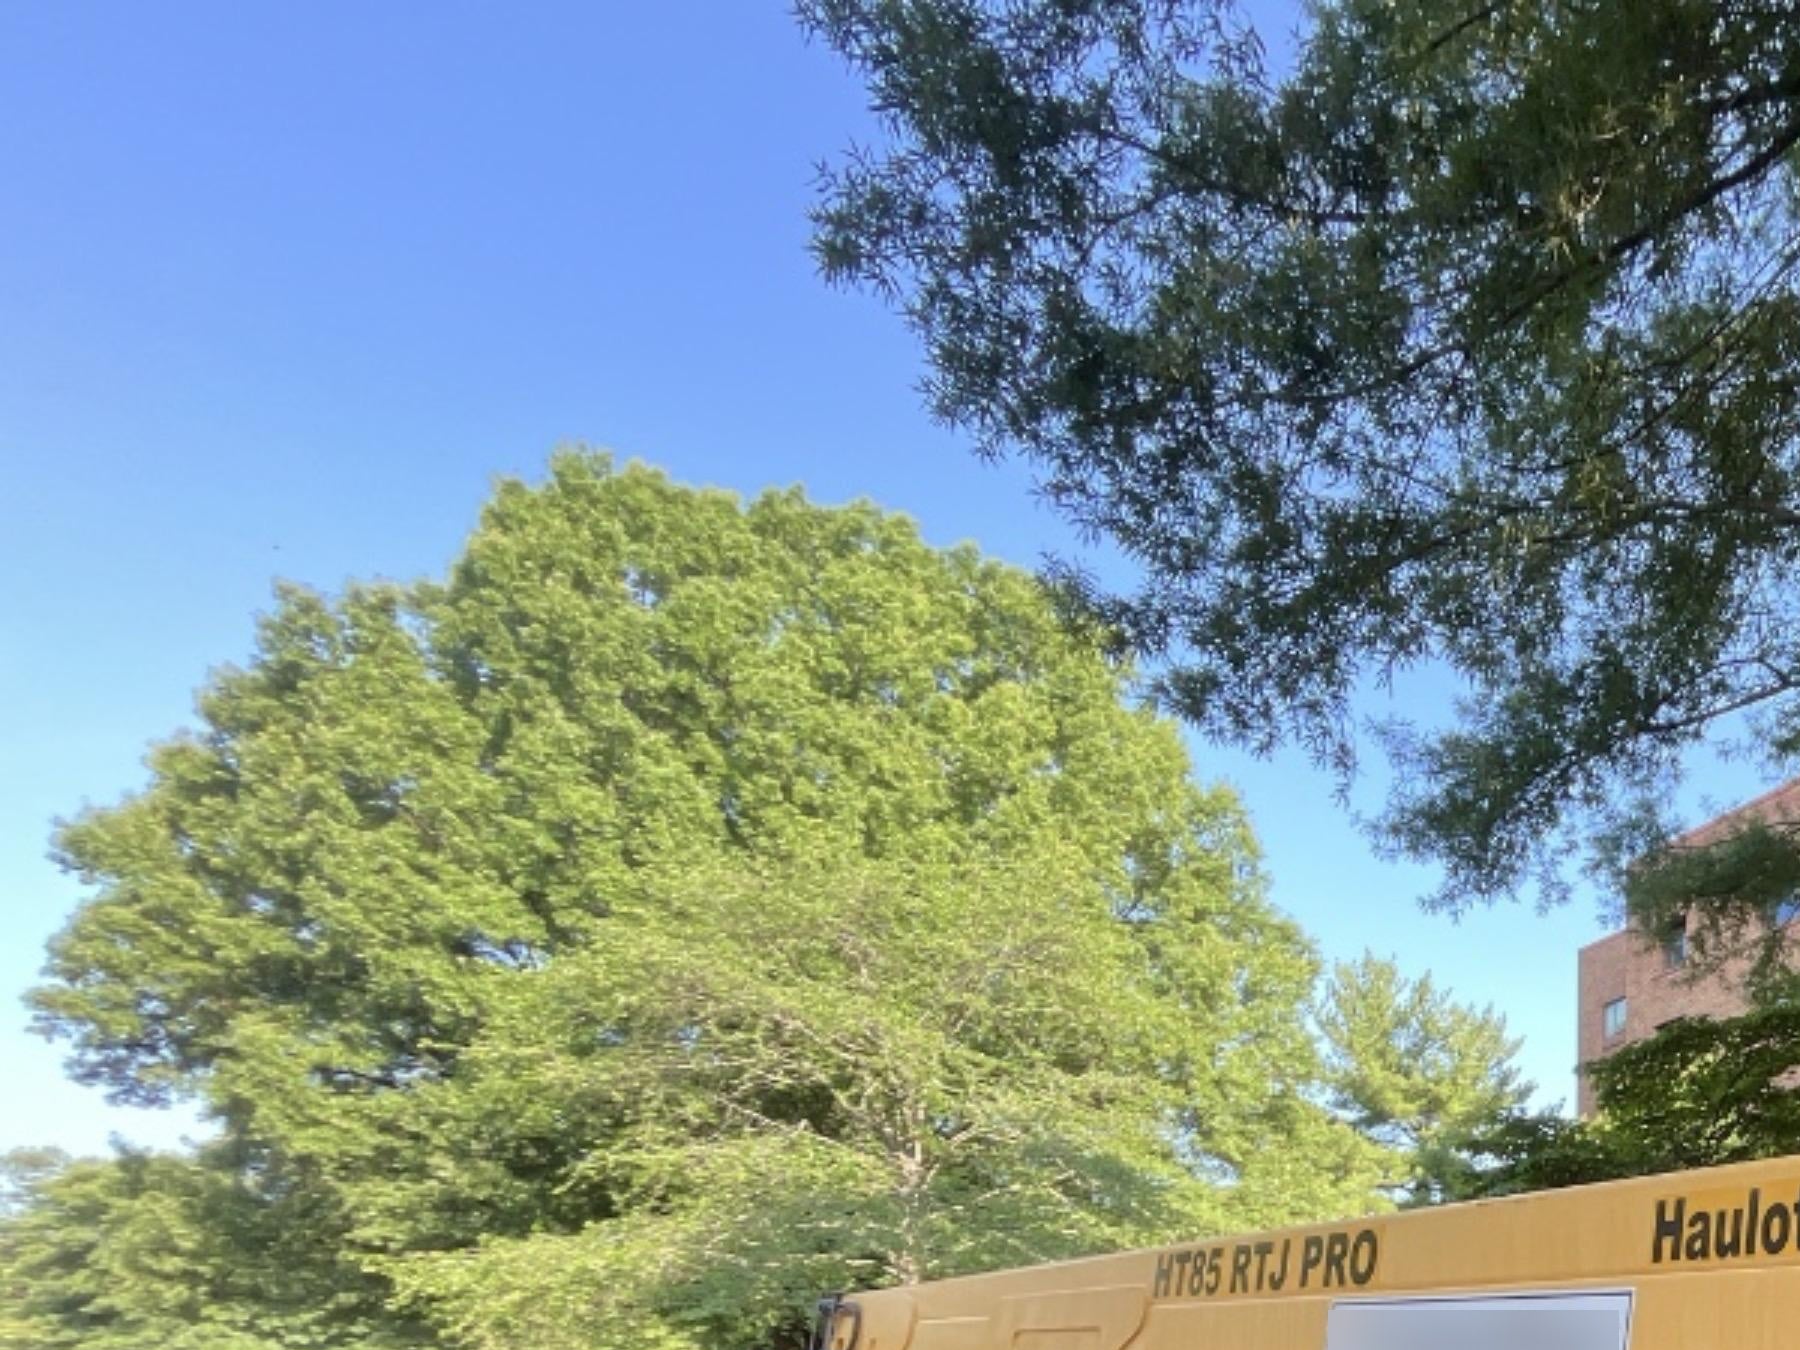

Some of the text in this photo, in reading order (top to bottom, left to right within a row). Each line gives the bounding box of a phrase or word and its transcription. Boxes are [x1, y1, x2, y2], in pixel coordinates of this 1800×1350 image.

[1153, 1229, 1378, 1298] HT85 RTJ PRO
